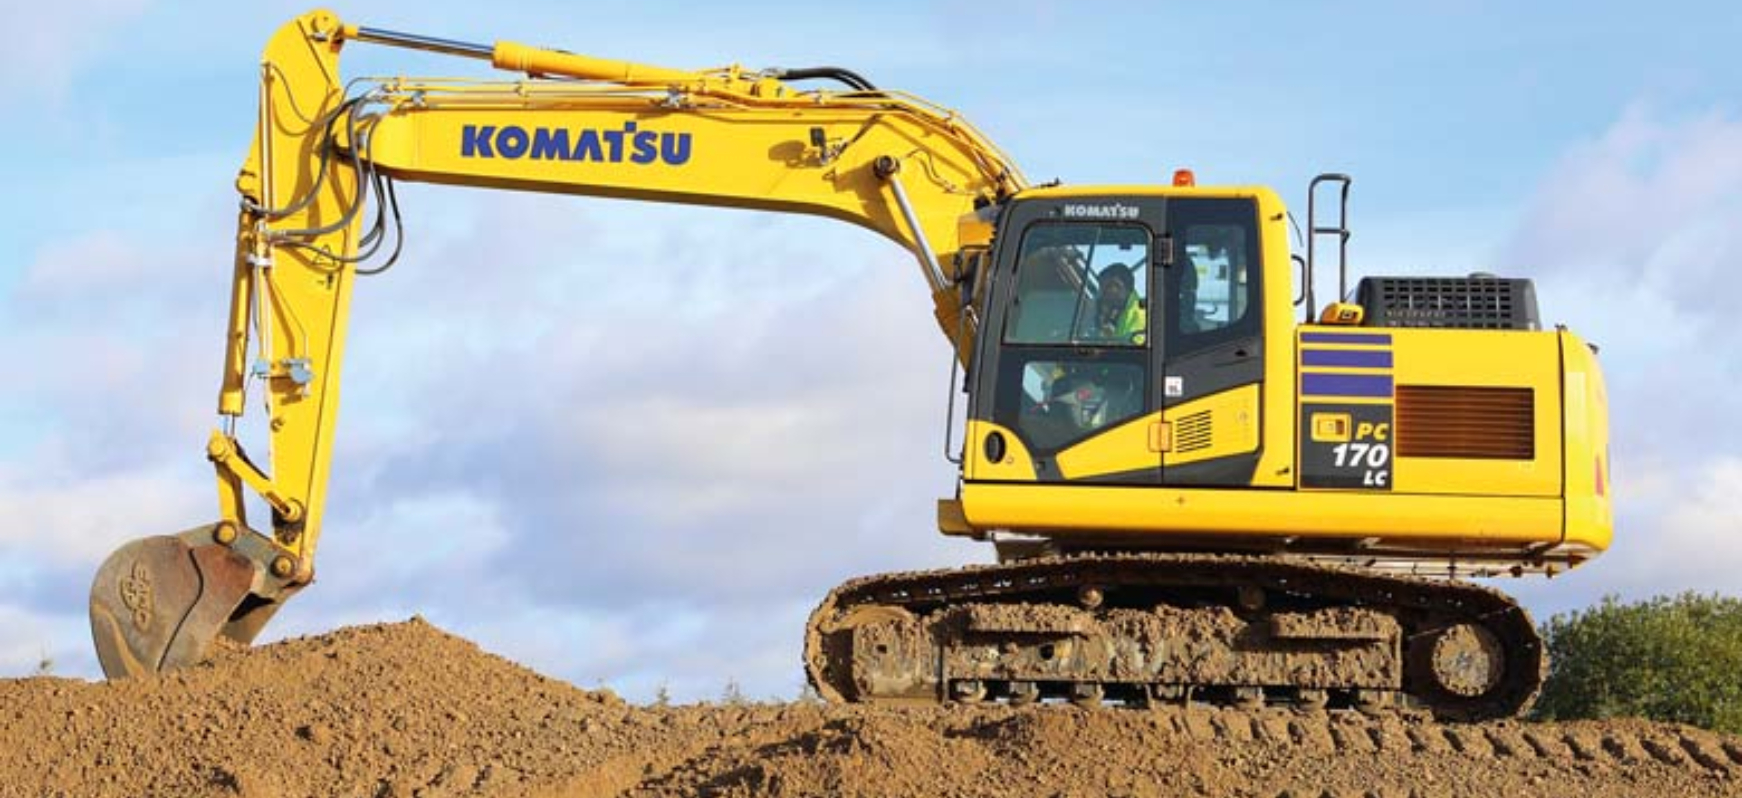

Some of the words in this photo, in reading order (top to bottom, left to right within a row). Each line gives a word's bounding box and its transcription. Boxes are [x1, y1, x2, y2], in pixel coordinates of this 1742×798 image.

[461, 121, 692, 165] KOMATSU
[1064, 203, 1139, 219] KOMATSU
[1355, 422, 1389, 440] PC
[1332, 443, 1389, 468] 170
[1363, 470, 1388, 486] LC
